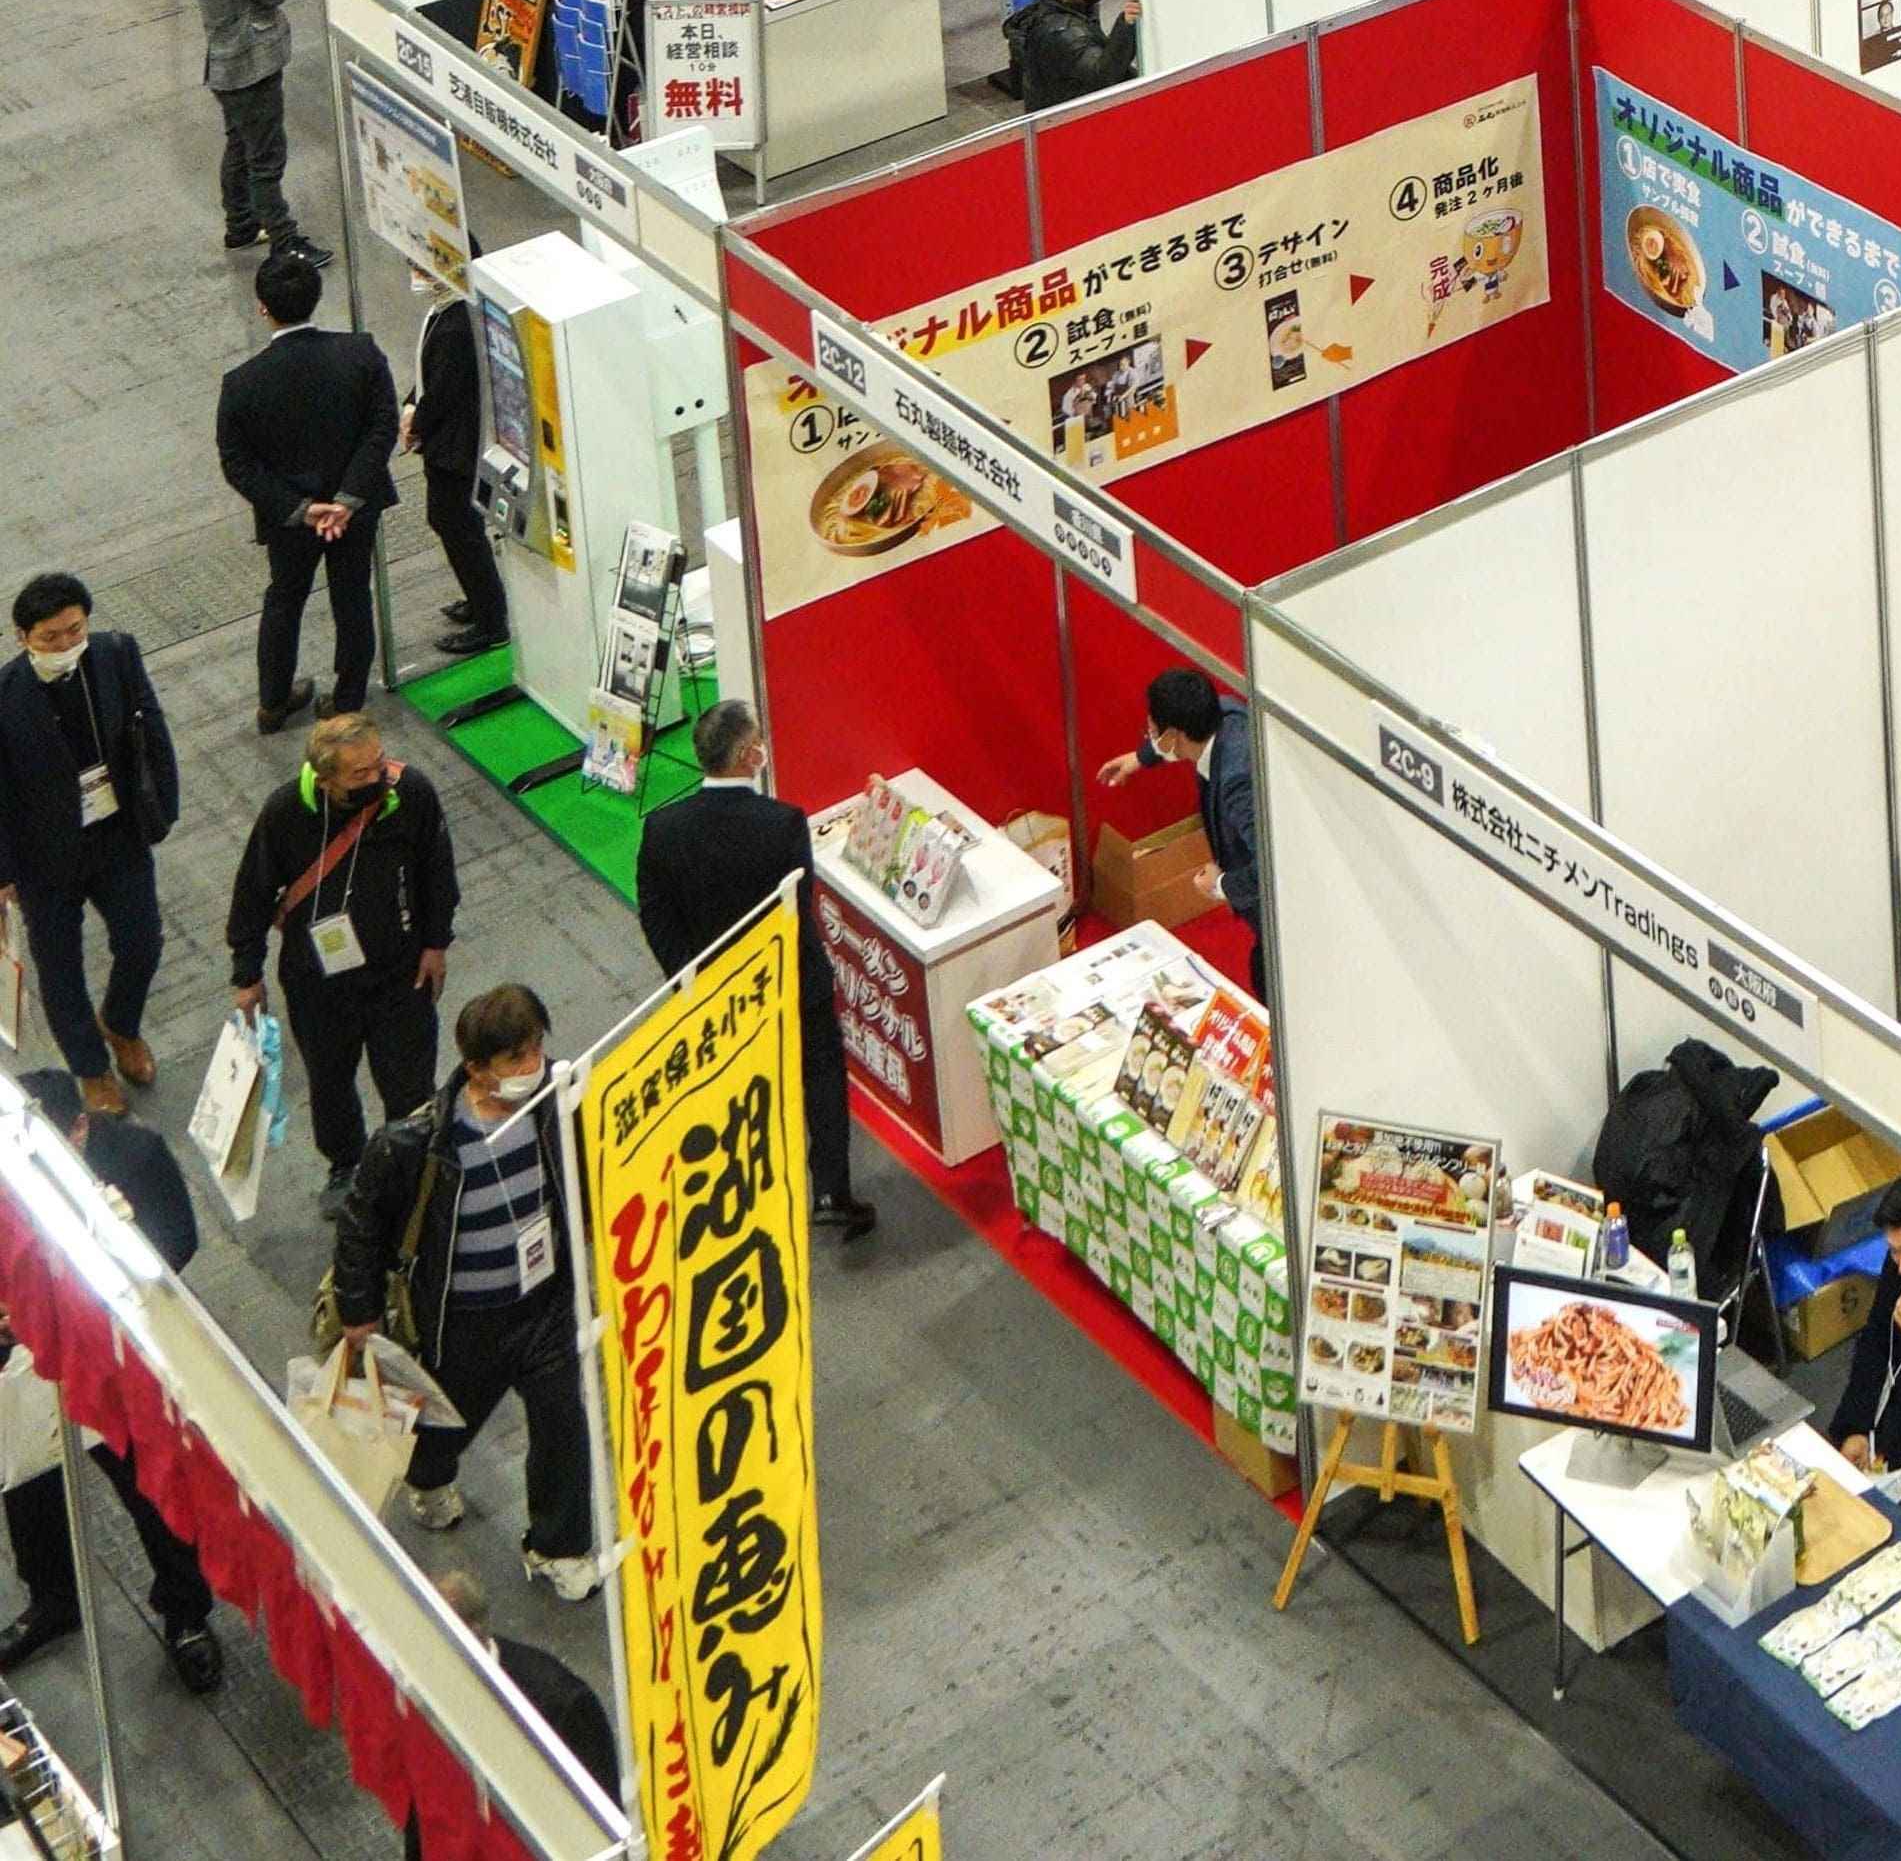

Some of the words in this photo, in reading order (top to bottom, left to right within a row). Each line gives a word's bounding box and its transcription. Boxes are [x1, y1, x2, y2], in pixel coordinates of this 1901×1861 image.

[665, 41, 739, 62] 経営相談
[680, 23, 726, 42] 本日、
[664, 77, 745, 119] 無料
[1431, 155, 1501, 199] 商品化
[1614, 96, 1783, 215] オリジナル商品
[1786, 199, 1901, 278] ができるまで
[1082, 213, 1247, 299] ができるまで
[1257, 218, 1350, 265] デザイン
[1428, 254, 1451, 303] 完成
[1065, 310, 1116, 347] 試食
[819, 337, 867, 393] 2C-12
[893, 387, 1024, 503] 石丸製麺株式会社
[1387, 739, 1436, 792] 2C-9
[1450, 778, 1700, 971] 株式会社ニチメンTradings
[677, 1075, 793, 1769] 湖国の恵み
